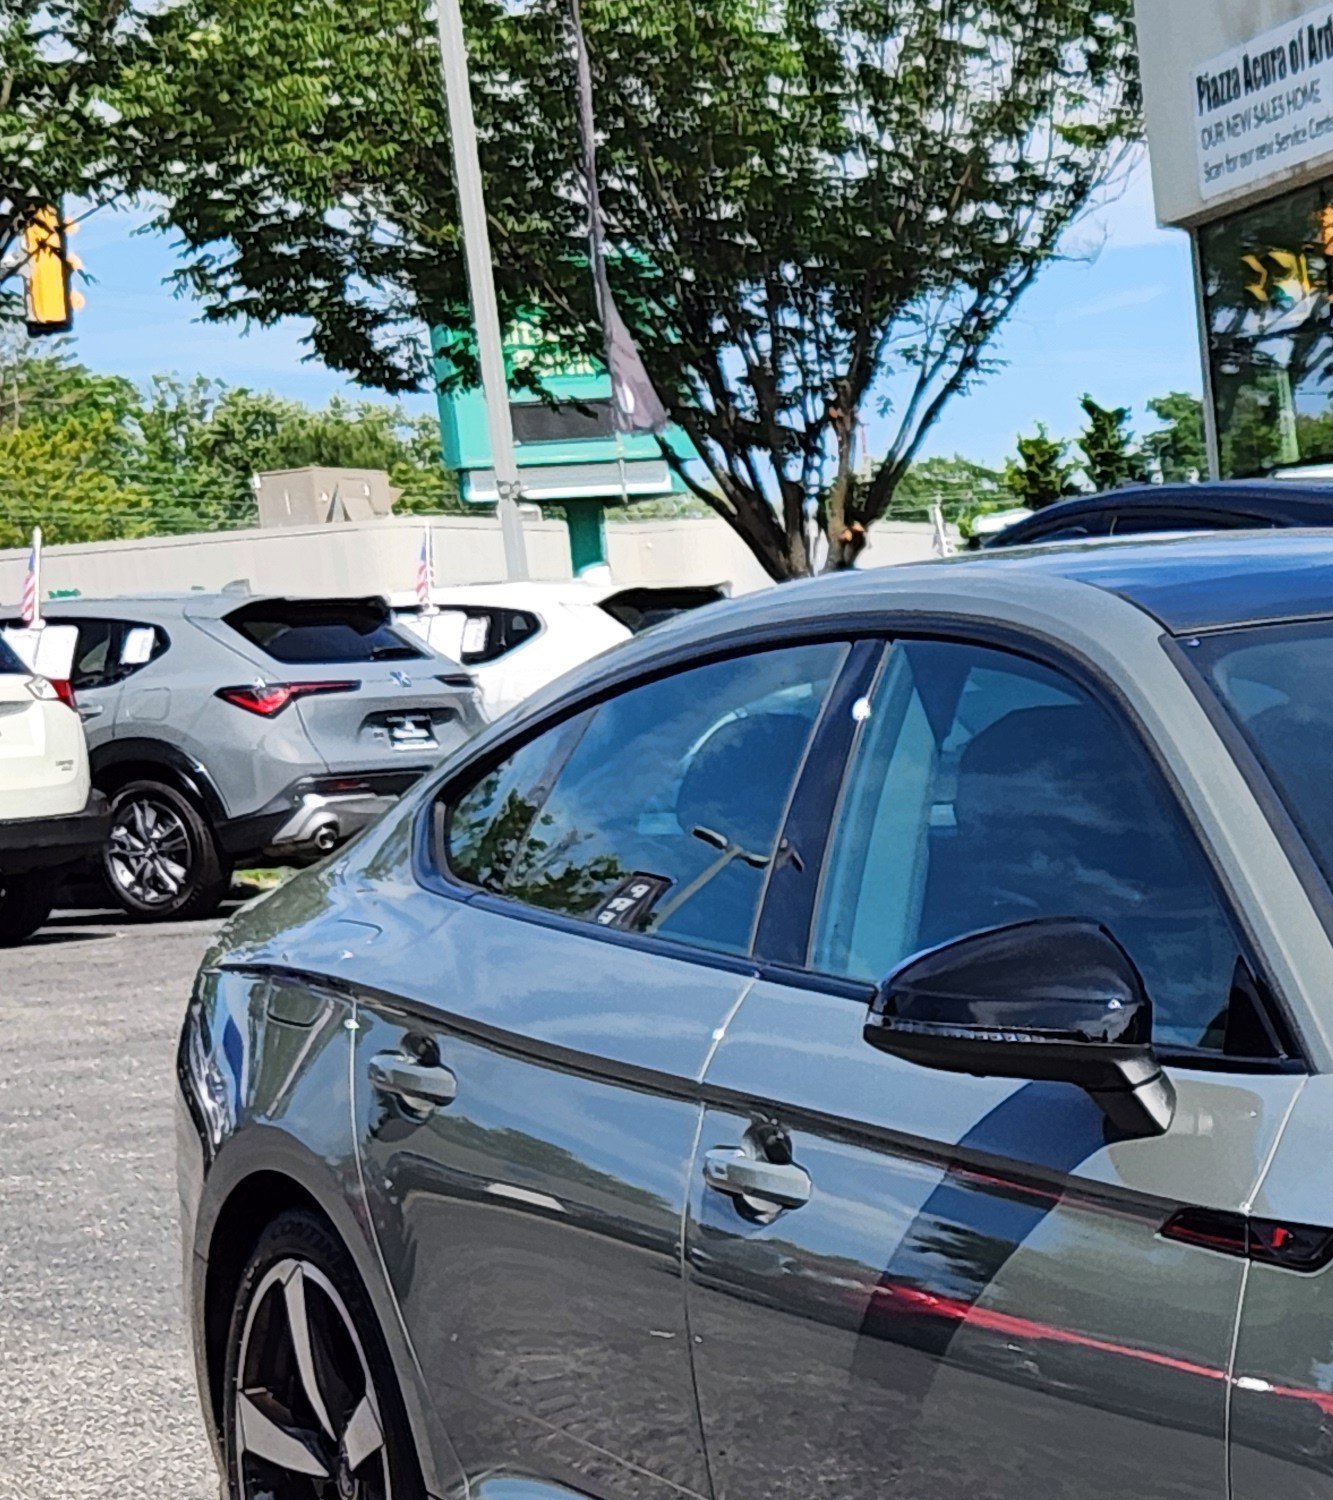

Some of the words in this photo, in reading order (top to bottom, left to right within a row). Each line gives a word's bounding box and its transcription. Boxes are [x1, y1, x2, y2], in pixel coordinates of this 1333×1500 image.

[1196, 65, 1242, 117] Piazza
[1243, 45, 1288, 97] Acura
[1289, 27, 1306, 76] of
[1253, 93, 1284, 129] SALES
[1286, 78, 1322, 116] HOME
